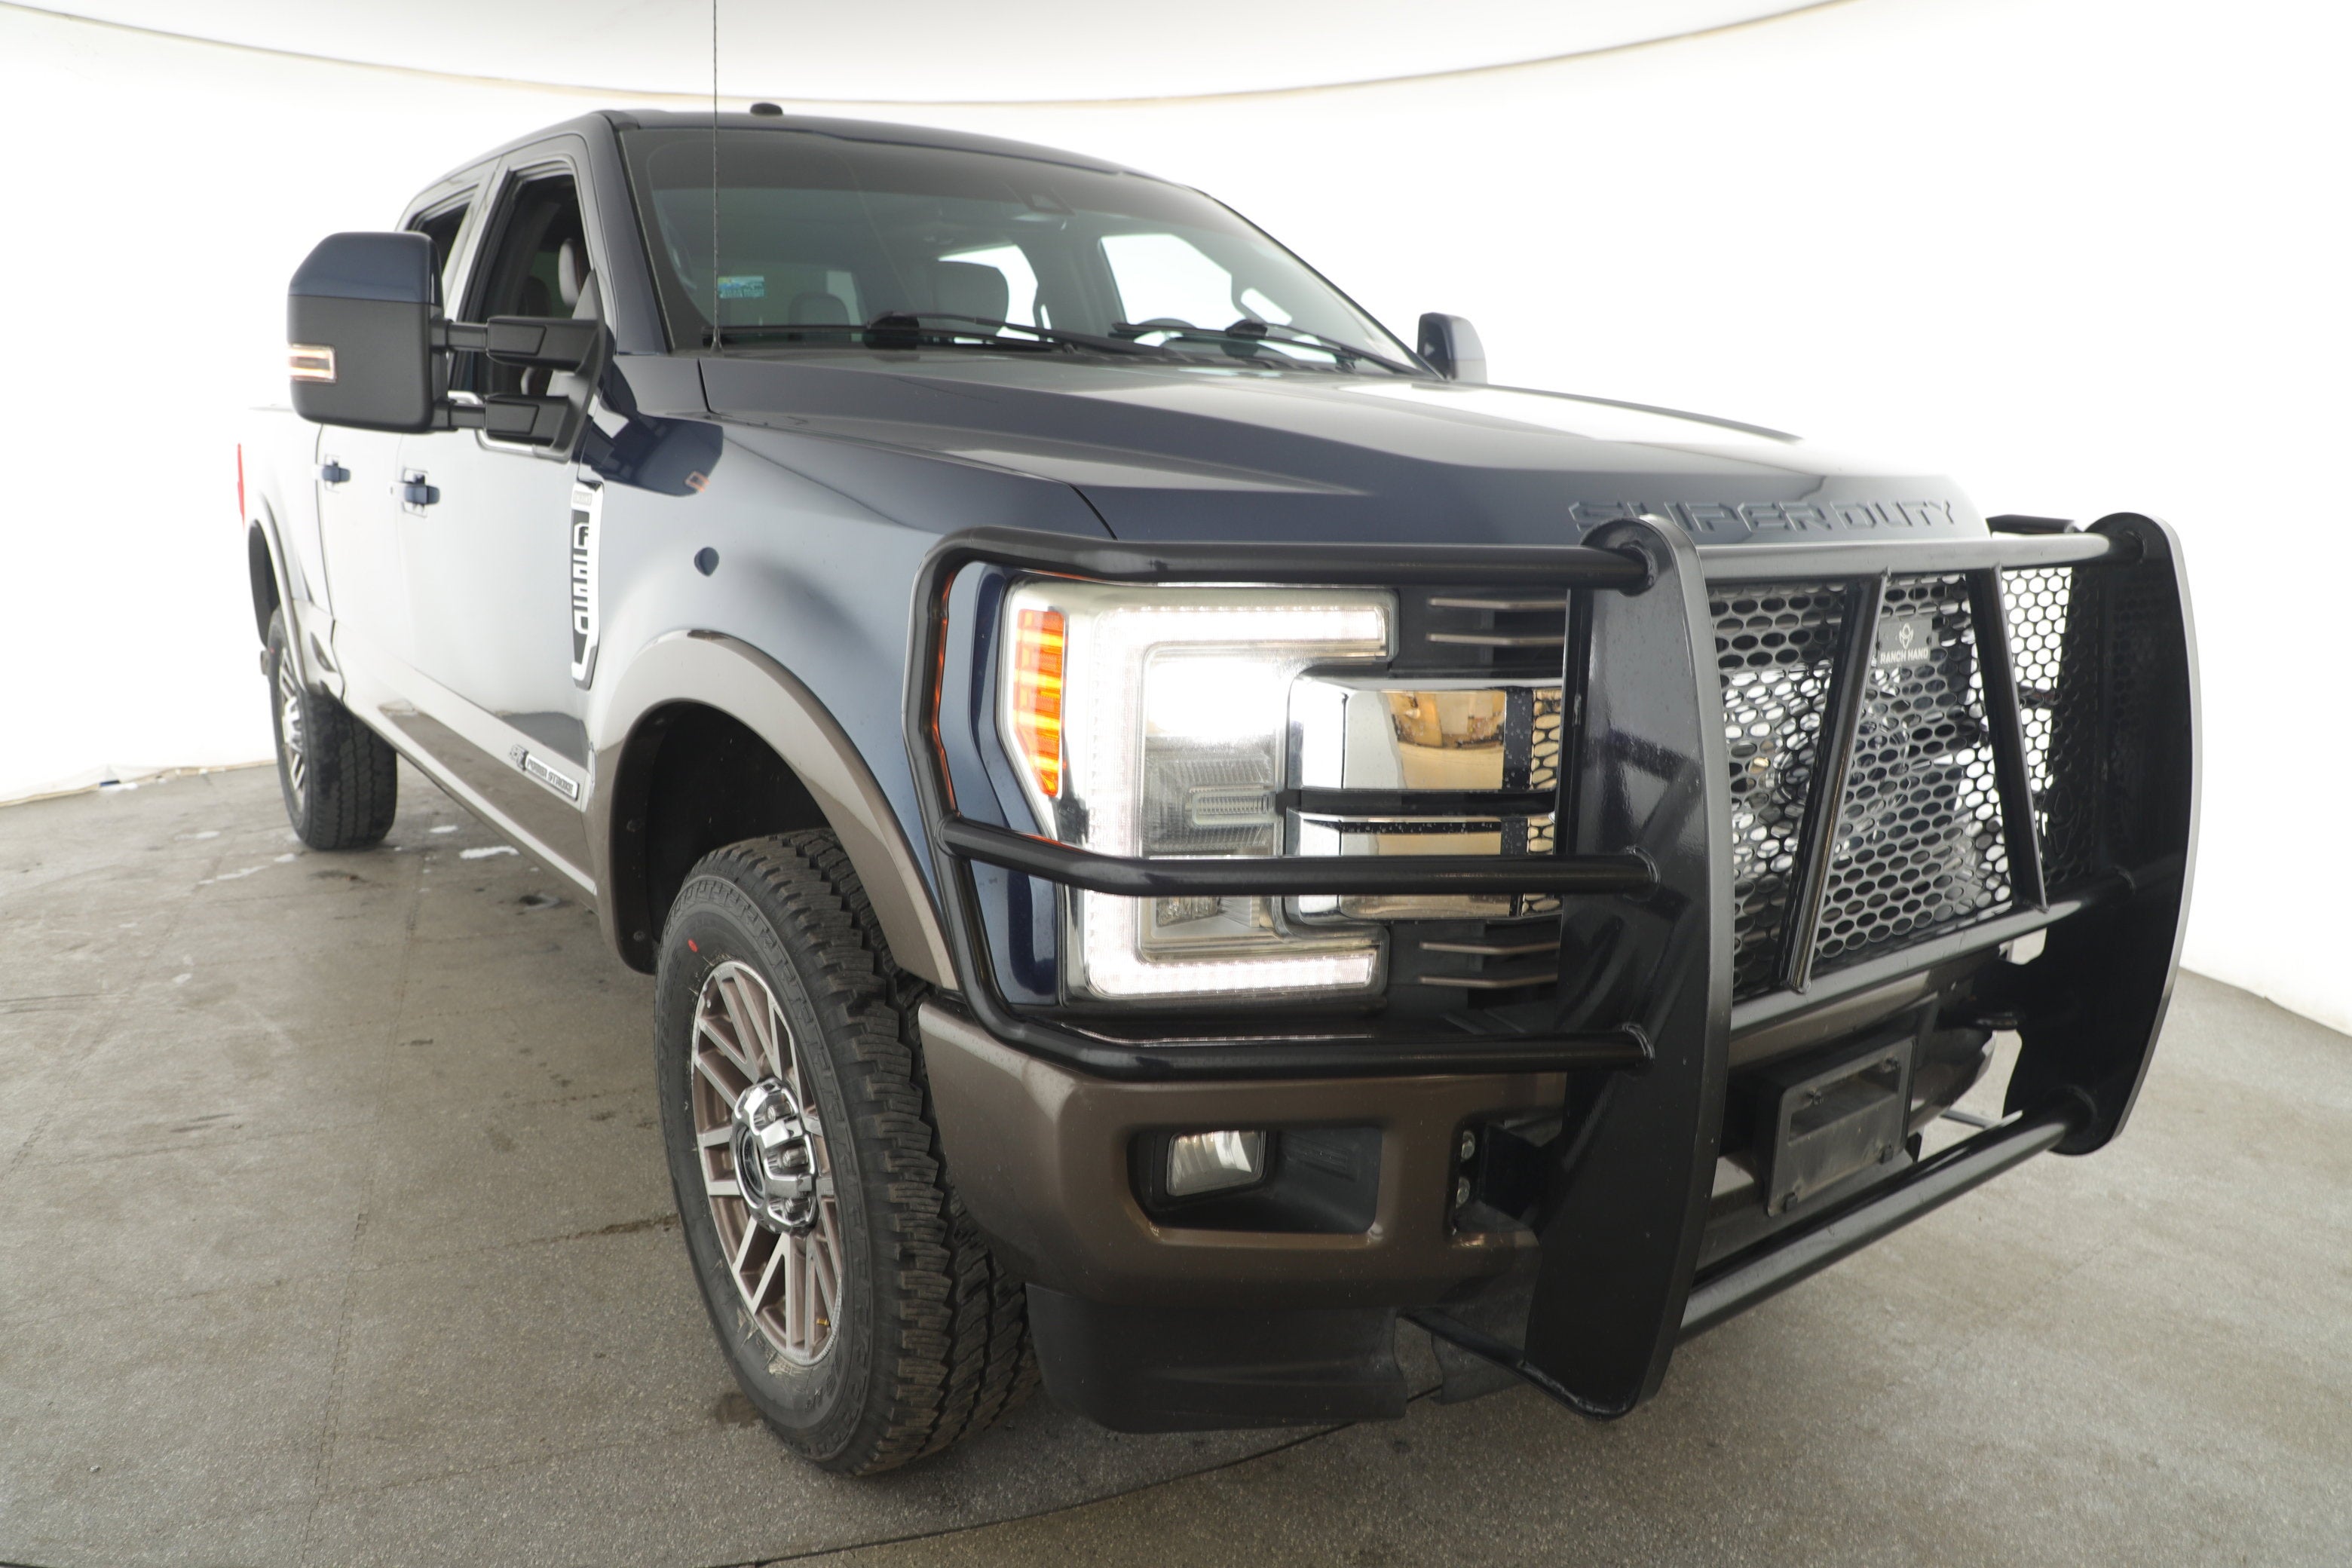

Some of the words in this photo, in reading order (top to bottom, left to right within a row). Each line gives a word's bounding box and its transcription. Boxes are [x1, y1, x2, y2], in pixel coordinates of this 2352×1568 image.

[1568, 501, 1833, 533] SUPER
[1830, 500, 1955, 530] DUTY
[1879, 648, 1906, 665] RANCH
[1907, 647, 1929, 661] HAND
